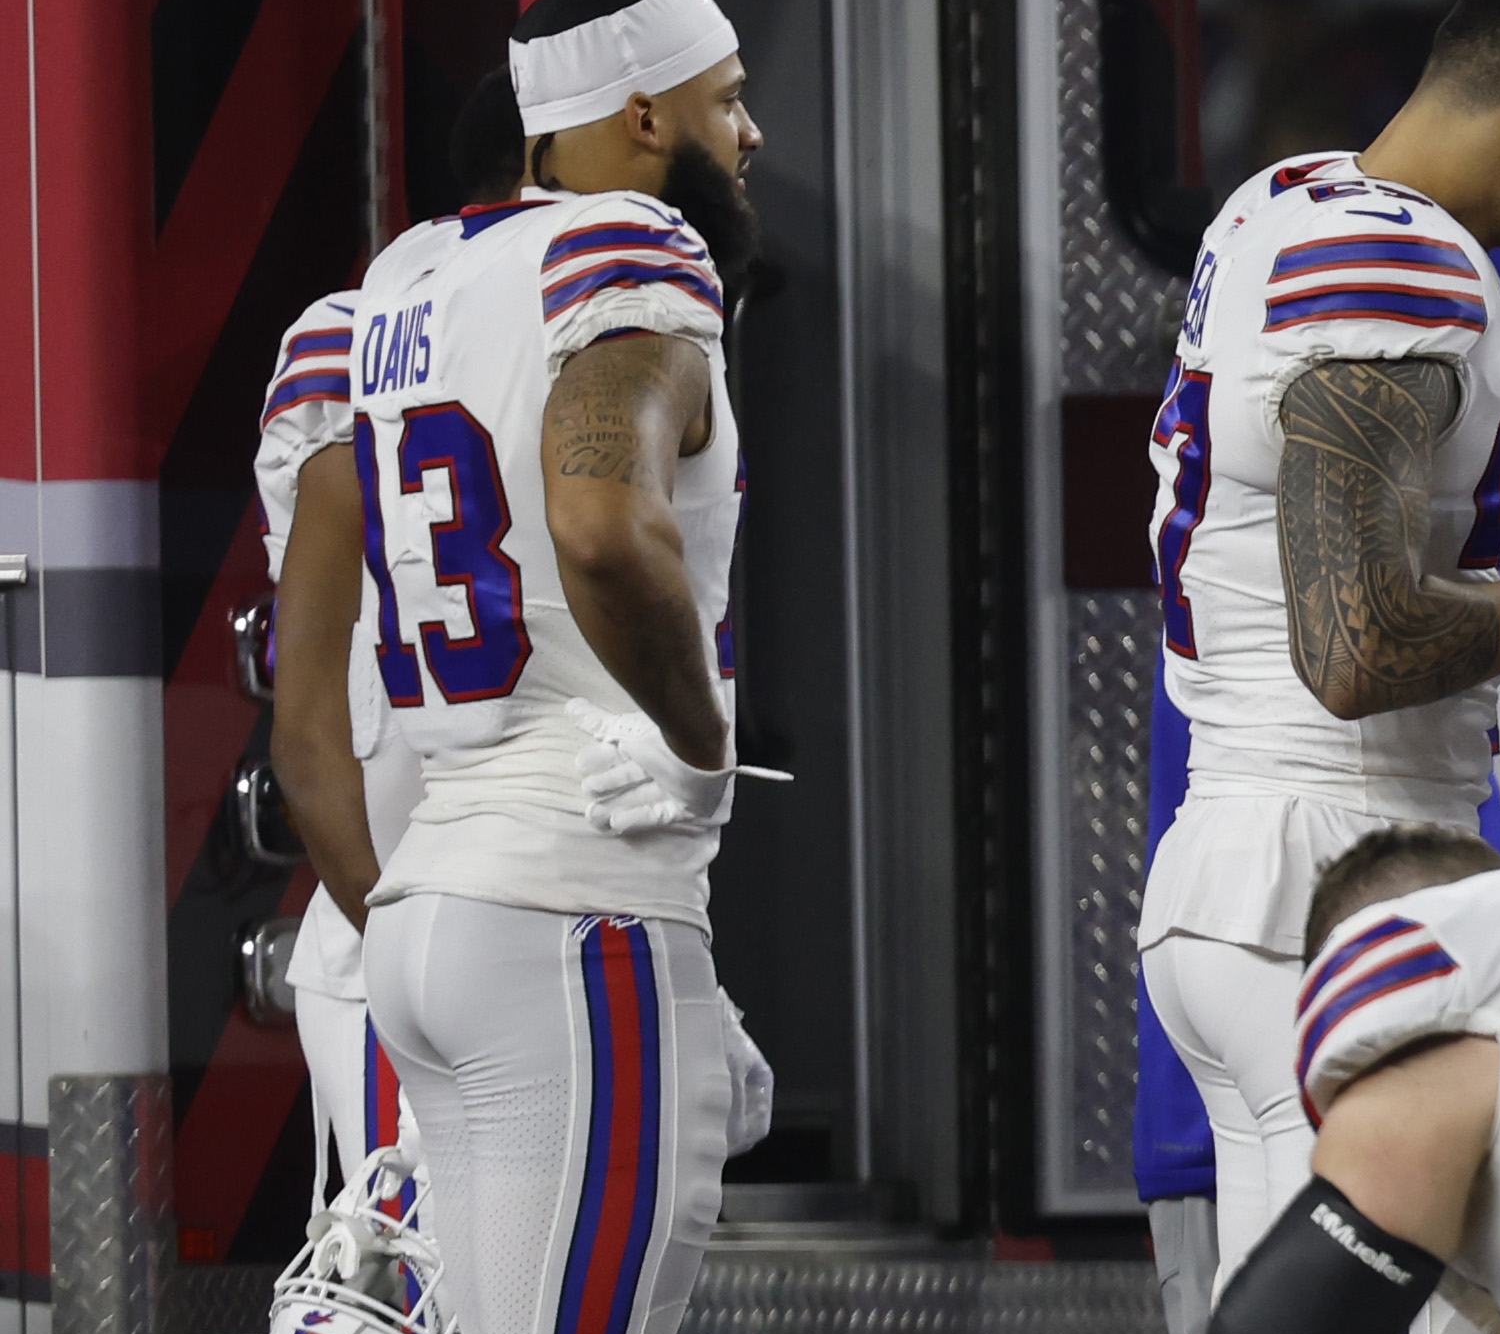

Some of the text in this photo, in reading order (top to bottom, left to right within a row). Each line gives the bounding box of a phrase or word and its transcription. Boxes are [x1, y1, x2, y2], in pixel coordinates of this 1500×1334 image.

[362, 300, 433, 397] DAVIS
[354, 401, 533, 708] 13
[1322, 1210, 1412, 1285] Mueller
